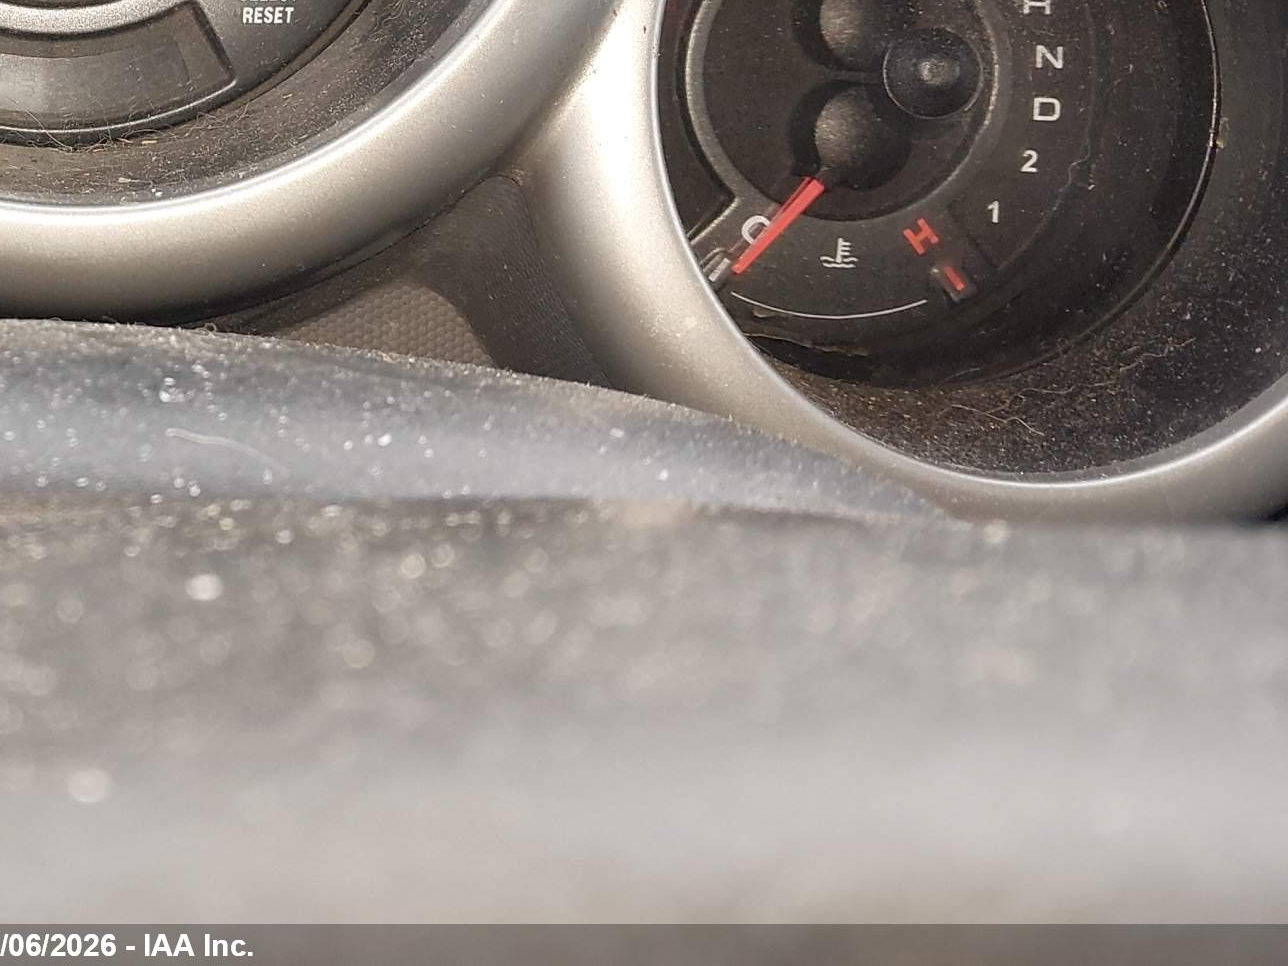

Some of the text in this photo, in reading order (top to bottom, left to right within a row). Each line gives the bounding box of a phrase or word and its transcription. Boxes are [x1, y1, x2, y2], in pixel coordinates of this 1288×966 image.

[242, 6, 295, 24] RESET
[1036, 45, 1063, 70] N
[1033, 97, 1062, 122] D
[1020, 150, 1039, 173] 2
[987, 201, 1000, 224] 1
[903, 218, 940, 255] H
